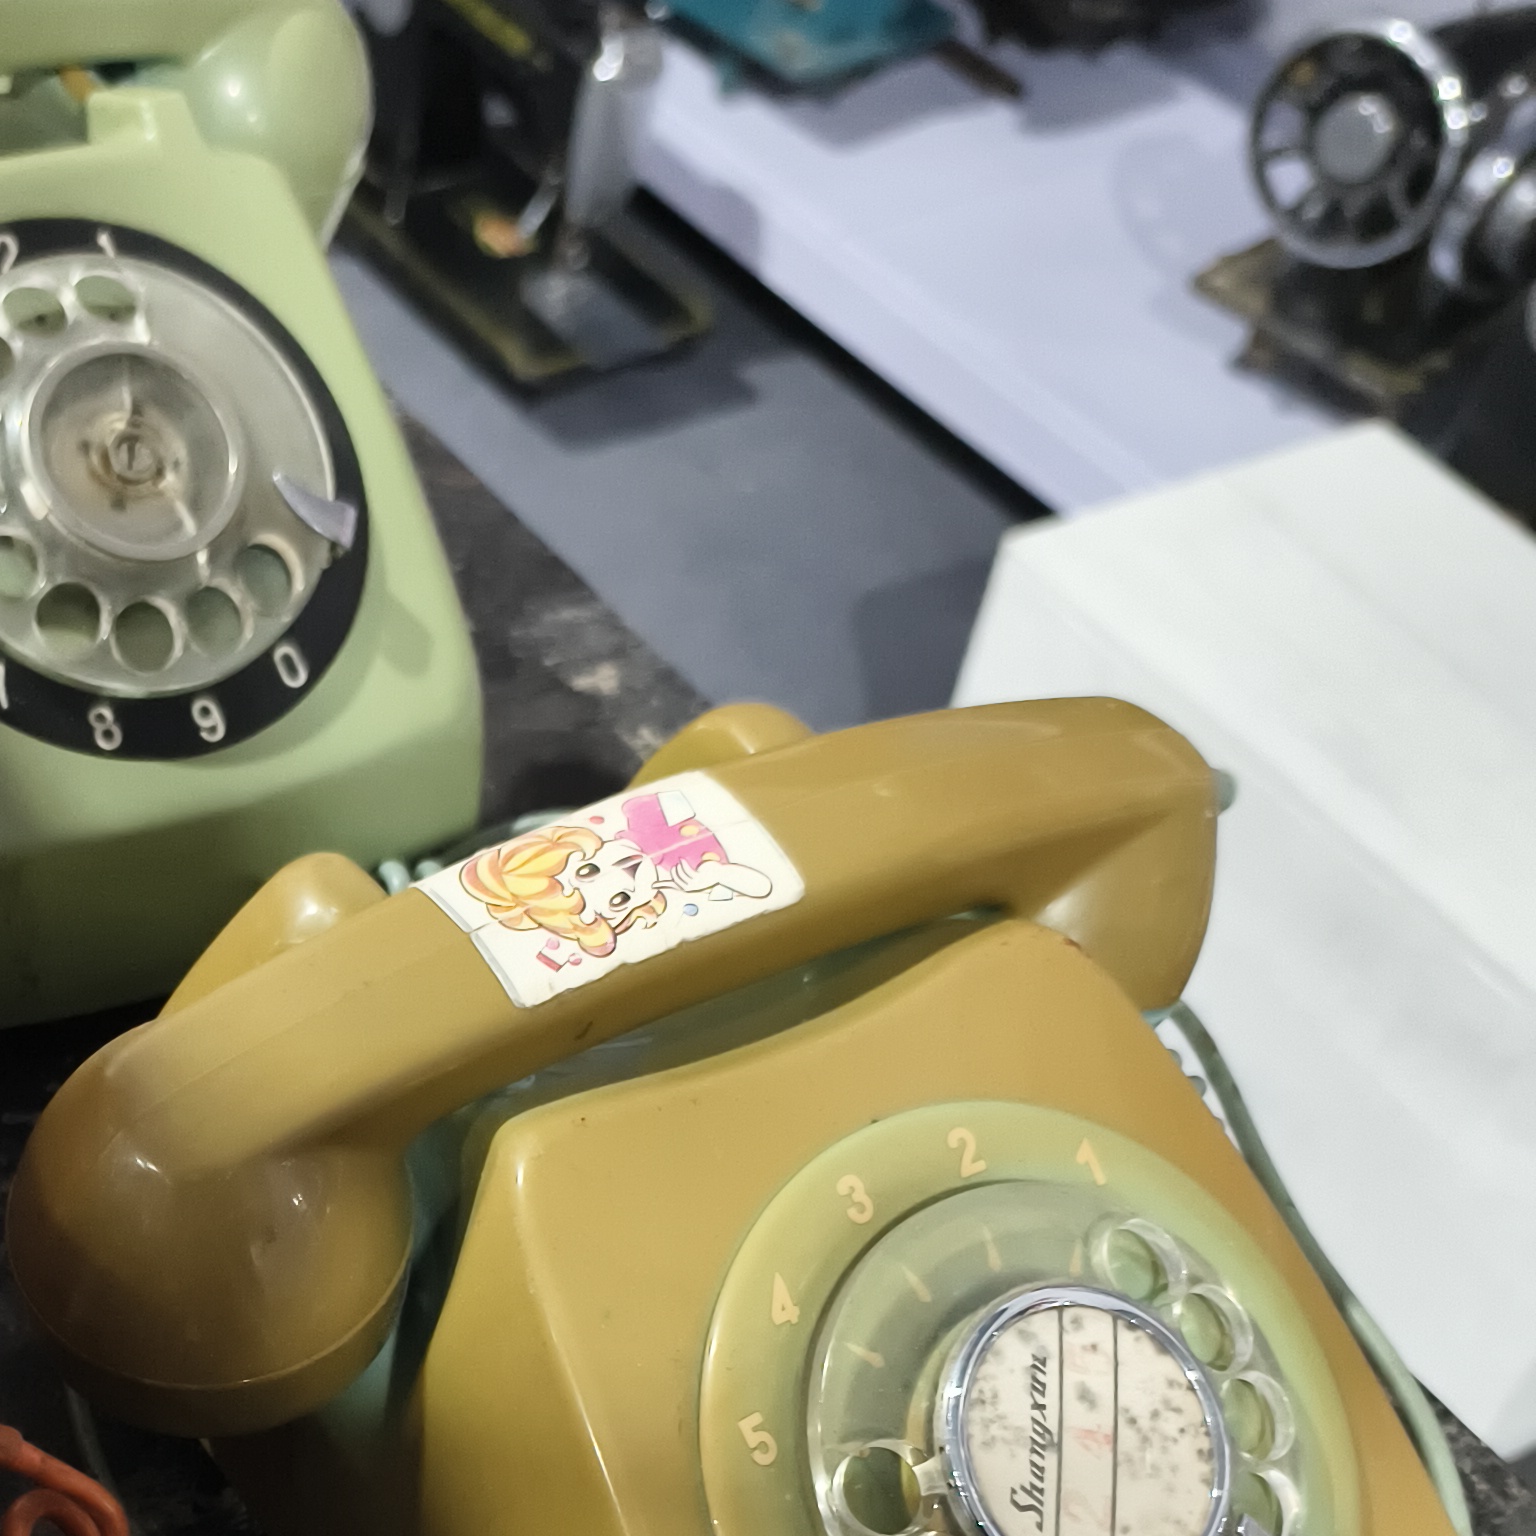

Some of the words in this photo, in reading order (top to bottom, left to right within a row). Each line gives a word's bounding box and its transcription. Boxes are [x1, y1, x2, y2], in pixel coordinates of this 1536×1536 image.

[96, 231, 116, 258] 1
[273, 645, 309, 689] 0
[87, 705, 123, 751] 8
[189, 697, 227, 743] 9
[946, 1127, 986, 1178] 2
[1075, 1138, 1108, 1185] 1
[835, 1174, 874, 1224] 3
[770, 1271, 800, 1326] 4
[737, 1411, 778, 1466] 5
